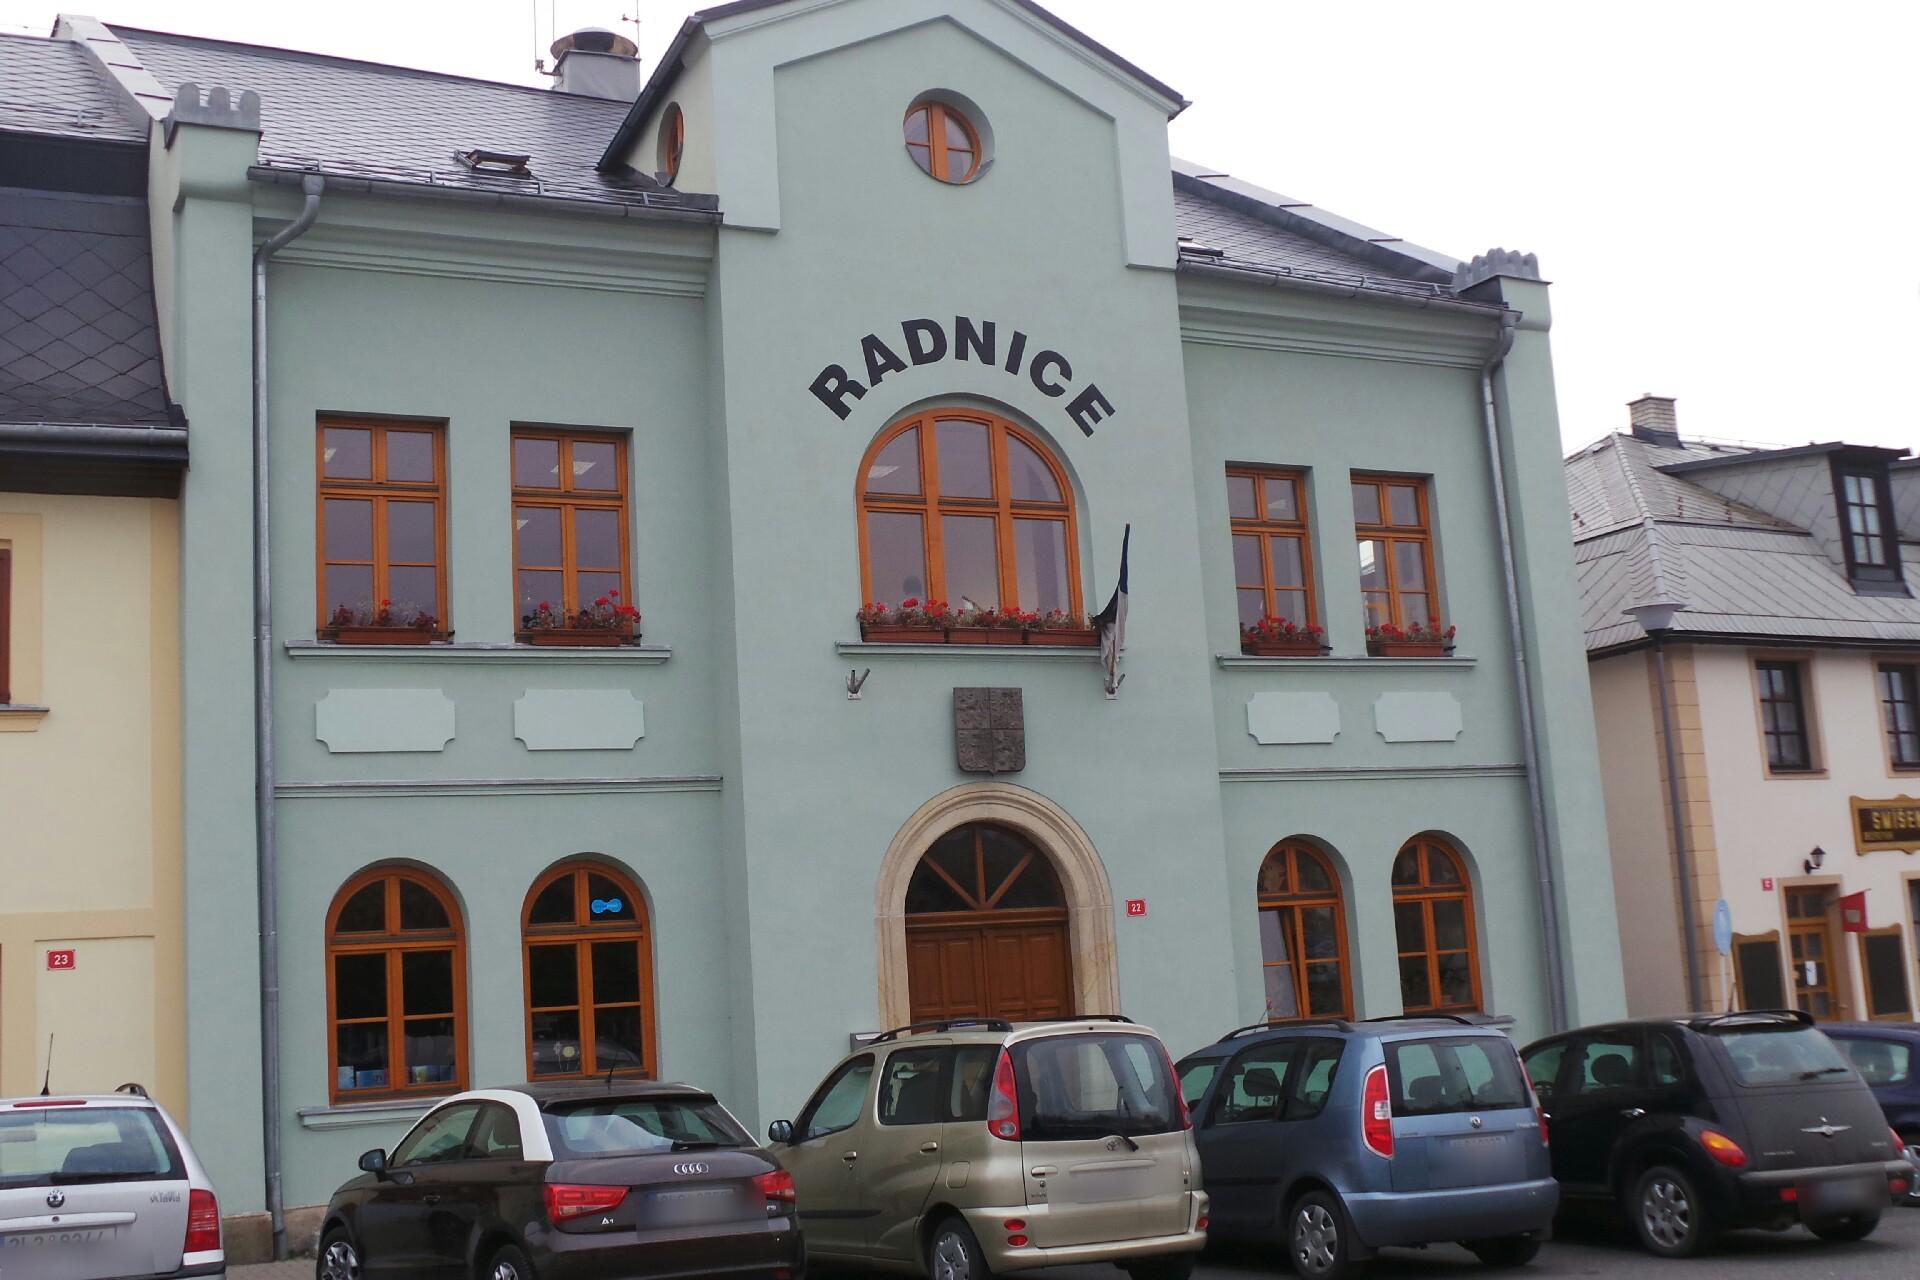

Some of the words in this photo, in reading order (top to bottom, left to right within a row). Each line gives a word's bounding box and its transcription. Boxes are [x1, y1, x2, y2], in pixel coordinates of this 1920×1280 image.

[808, 315, 1116, 438] RADNICE
[1131, 903, 1141, 913] 22
[54, 954, 68, 966] 23
